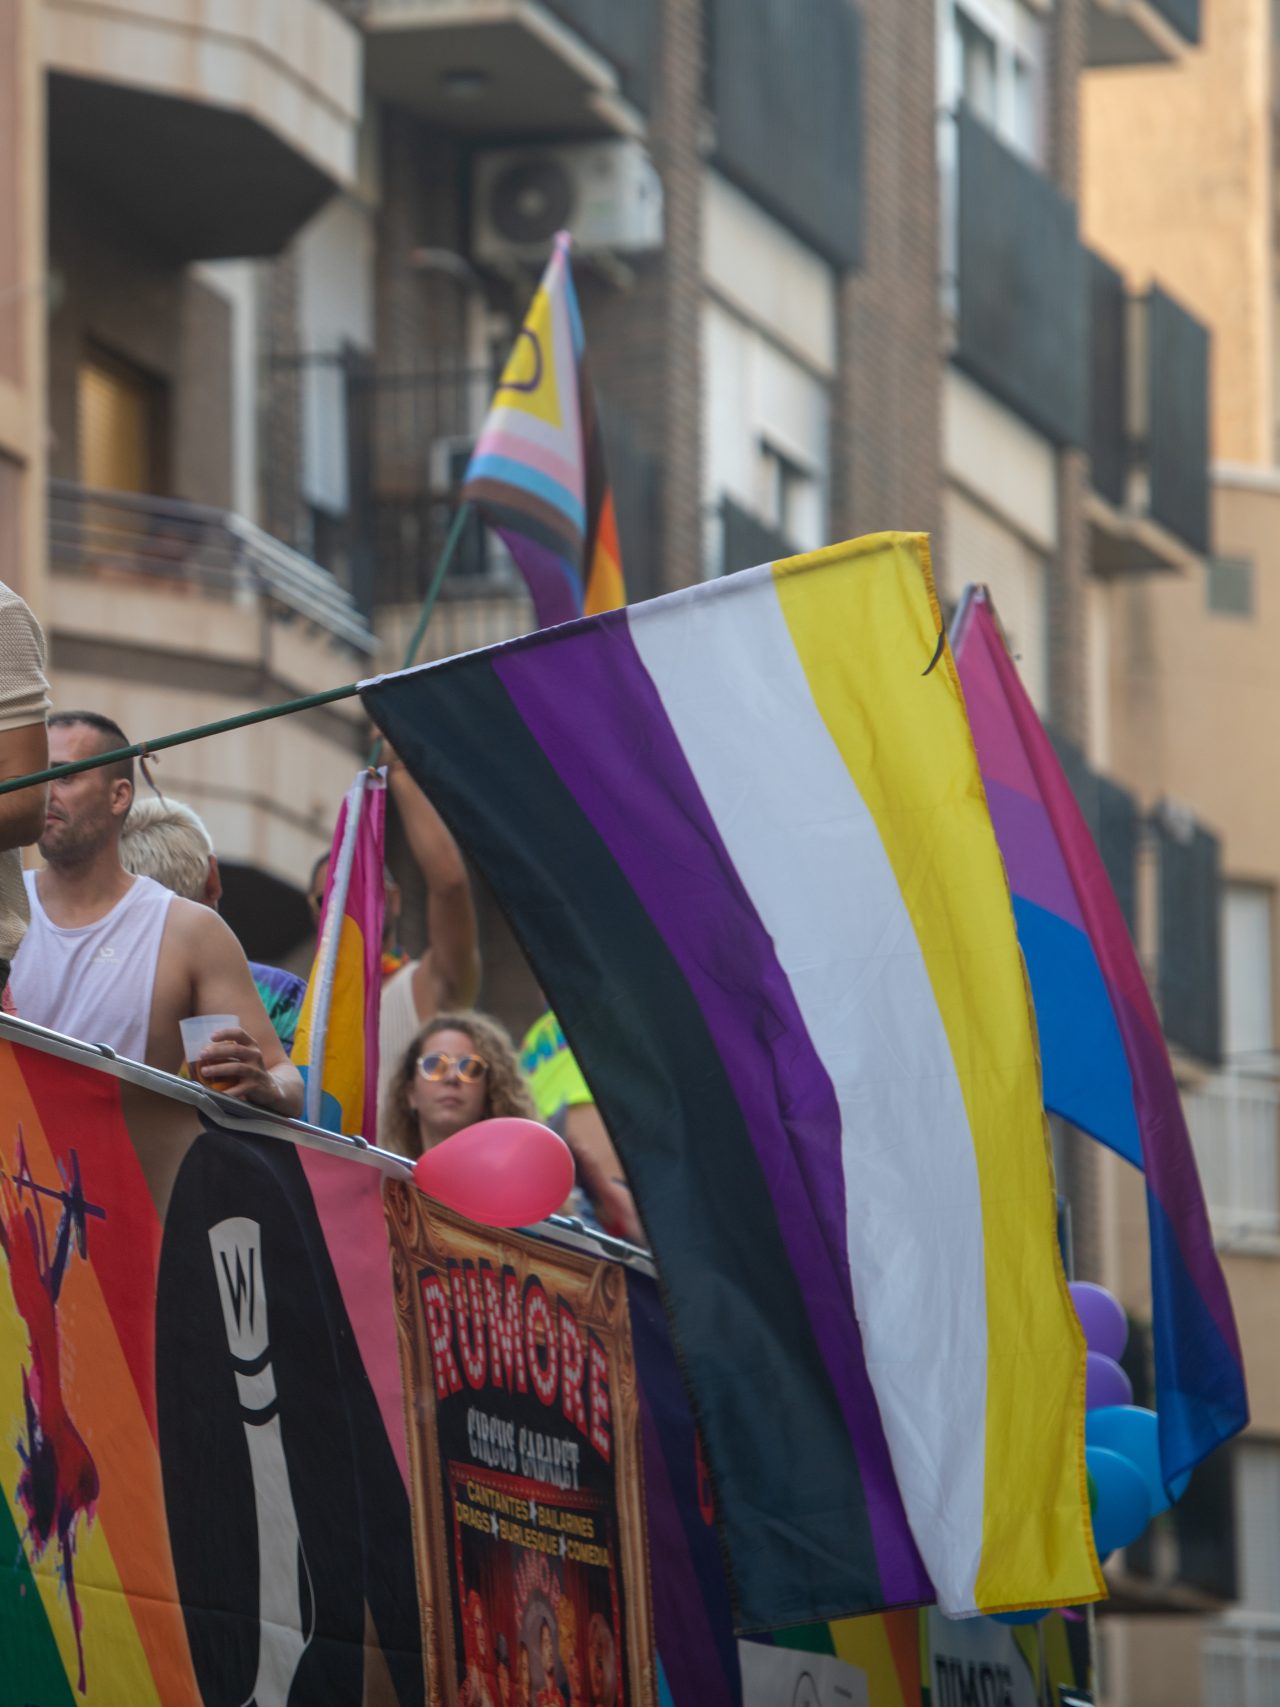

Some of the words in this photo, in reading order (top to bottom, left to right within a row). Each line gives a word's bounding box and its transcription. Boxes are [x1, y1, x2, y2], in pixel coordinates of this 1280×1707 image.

[418, 1256, 611, 1464] RUMORE
[467, 1405, 517, 1473] CIRCUS
[519, 1425, 580, 1491] CABARET
[455, 1500, 490, 1535] DRAGS
[499, 1519, 558, 1557] BURLESQUE
[466, 1480, 529, 1521] CANTANTES
[538, 1506, 595, 1539] BAILARINES
